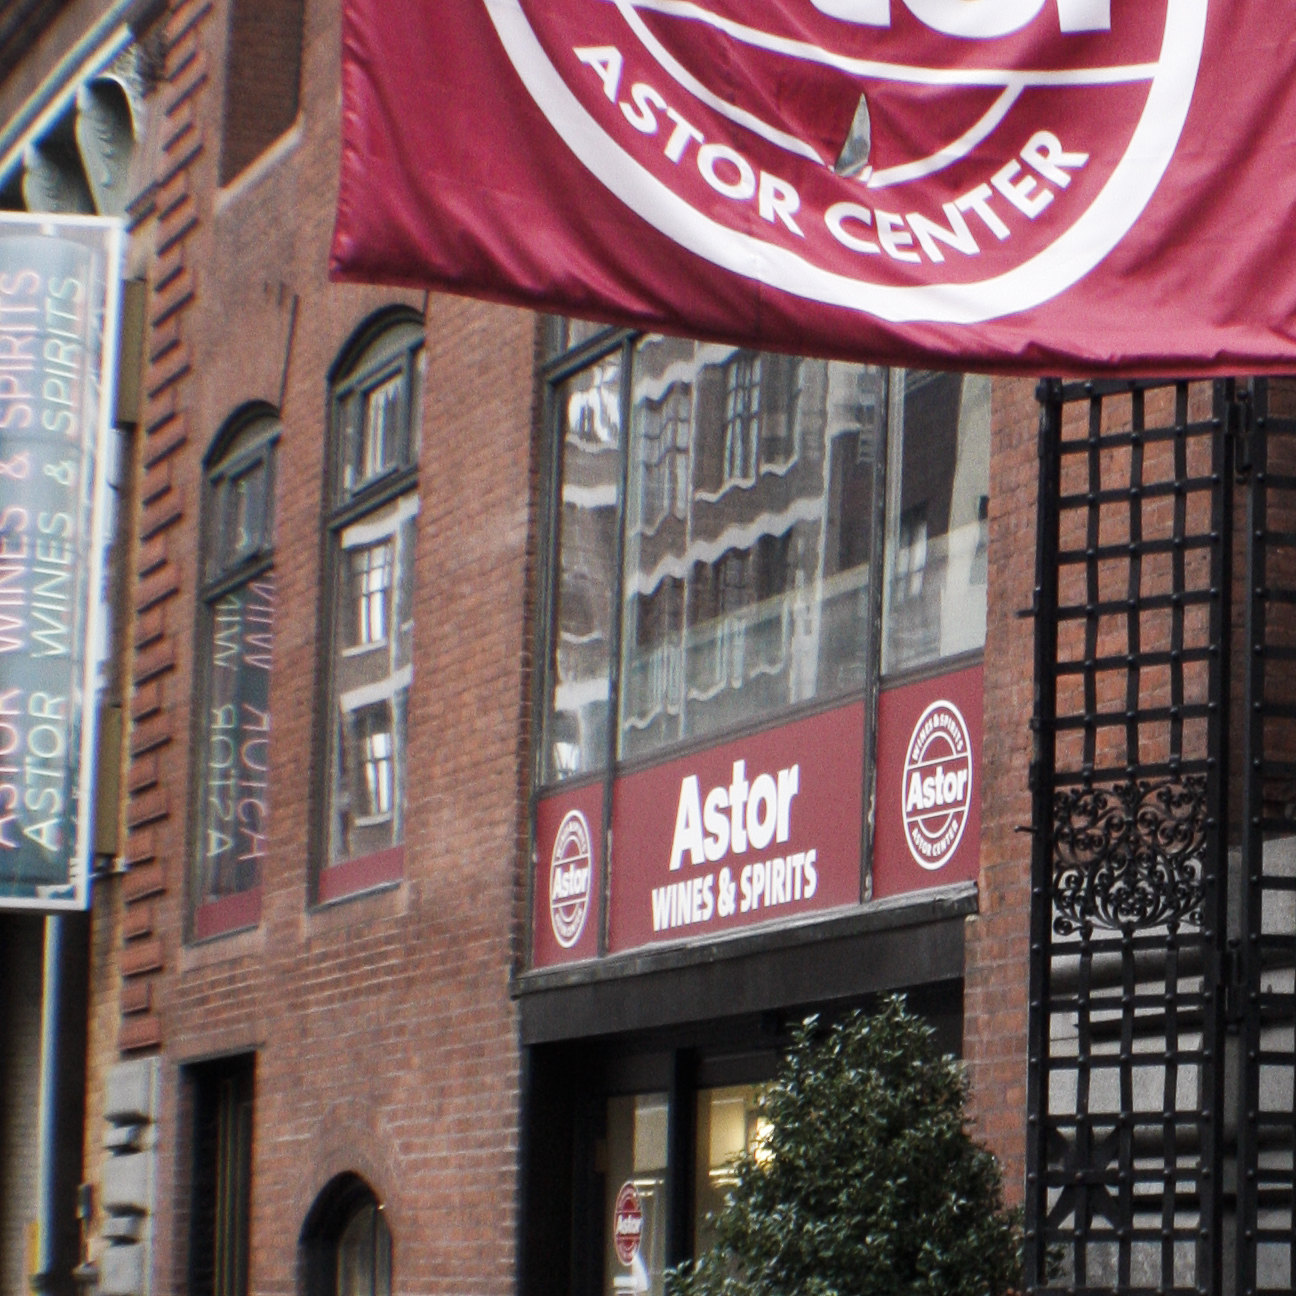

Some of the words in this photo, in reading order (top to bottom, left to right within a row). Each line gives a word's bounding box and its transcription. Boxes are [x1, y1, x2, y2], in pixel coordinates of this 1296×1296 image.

[573, 44, 804, 237] ASTOR
[826, 129, 1090, 266] CENTER
[42, 276, 84, 438] SPIRITS
[43, 457, 76, 486] &
[31, 510, 74, 659] WINES
[24, 691, 67, 852] ASTOR
[912, 716, 934, 761] WINES
[940, 712, 965, 752] SPIRITS
[669, 759, 799, 871] Astor
[906, 766, 968, 812] Astor
[911, 826, 932, 857] ASTOR
[932, 819, 958, 857] CENTER
[552, 864, 589, 901] Astor
[651, 872, 714, 932] WINES
[717, 867, 737, 917] &
[740, 849, 817, 915] SPIRITS
